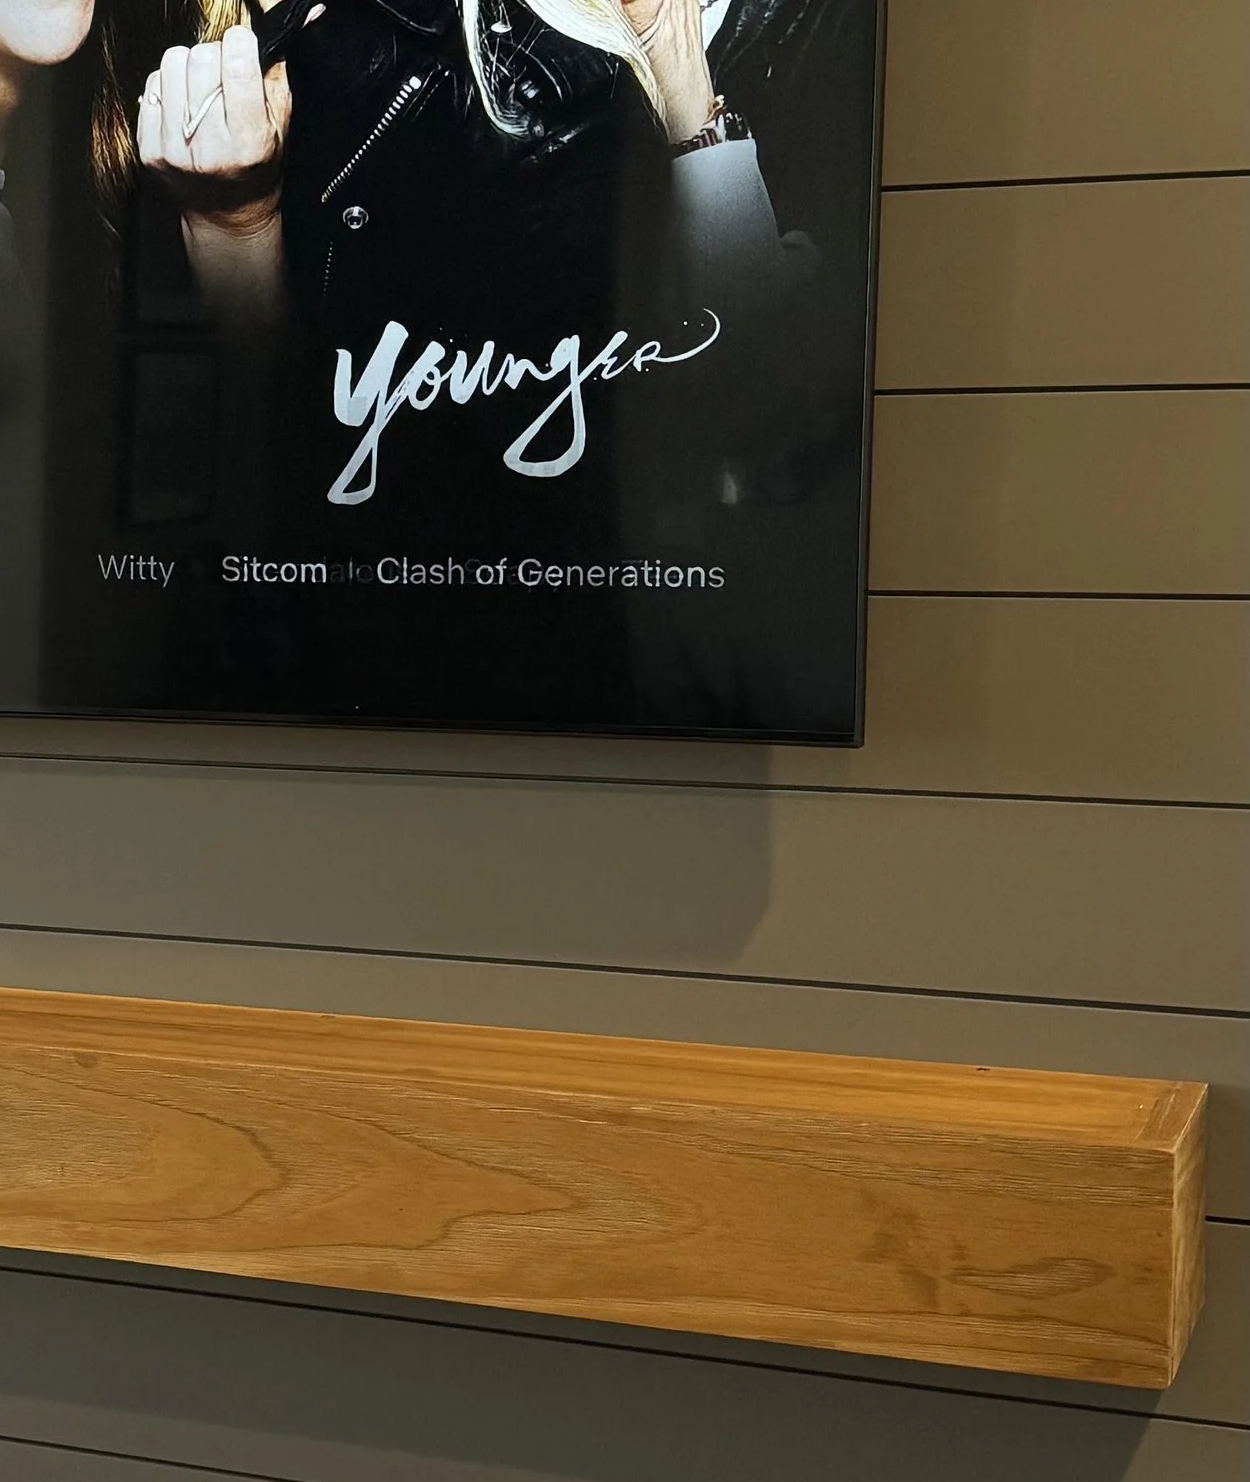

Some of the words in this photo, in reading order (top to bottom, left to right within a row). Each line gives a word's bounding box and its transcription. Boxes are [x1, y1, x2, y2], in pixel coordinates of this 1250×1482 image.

[98, 554, 175, 588] Witty
[222, 555, 327, 583] Sitcom
[377, 556, 464, 585] Clash
[476, 557, 508, 586] of
[517, 558, 726, 588] Generations
